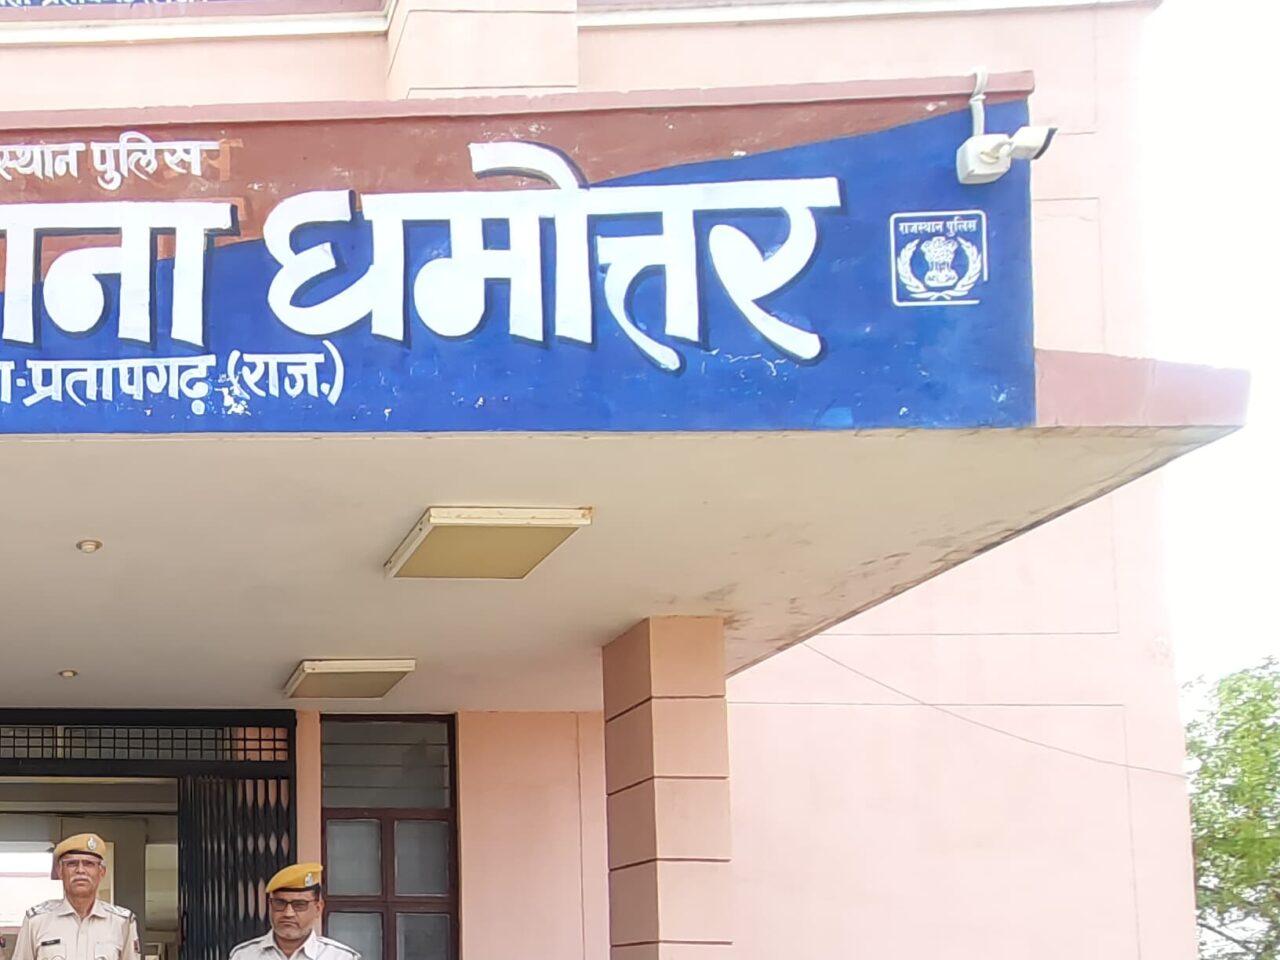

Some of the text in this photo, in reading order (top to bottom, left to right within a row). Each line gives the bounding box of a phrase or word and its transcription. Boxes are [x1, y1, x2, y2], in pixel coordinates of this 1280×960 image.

[89, 131, 220, 190] पुलिस
[898, 216, 978, 237] राजस्थान पुलिस
[262, 141, 842, 374] धमोत्तर
